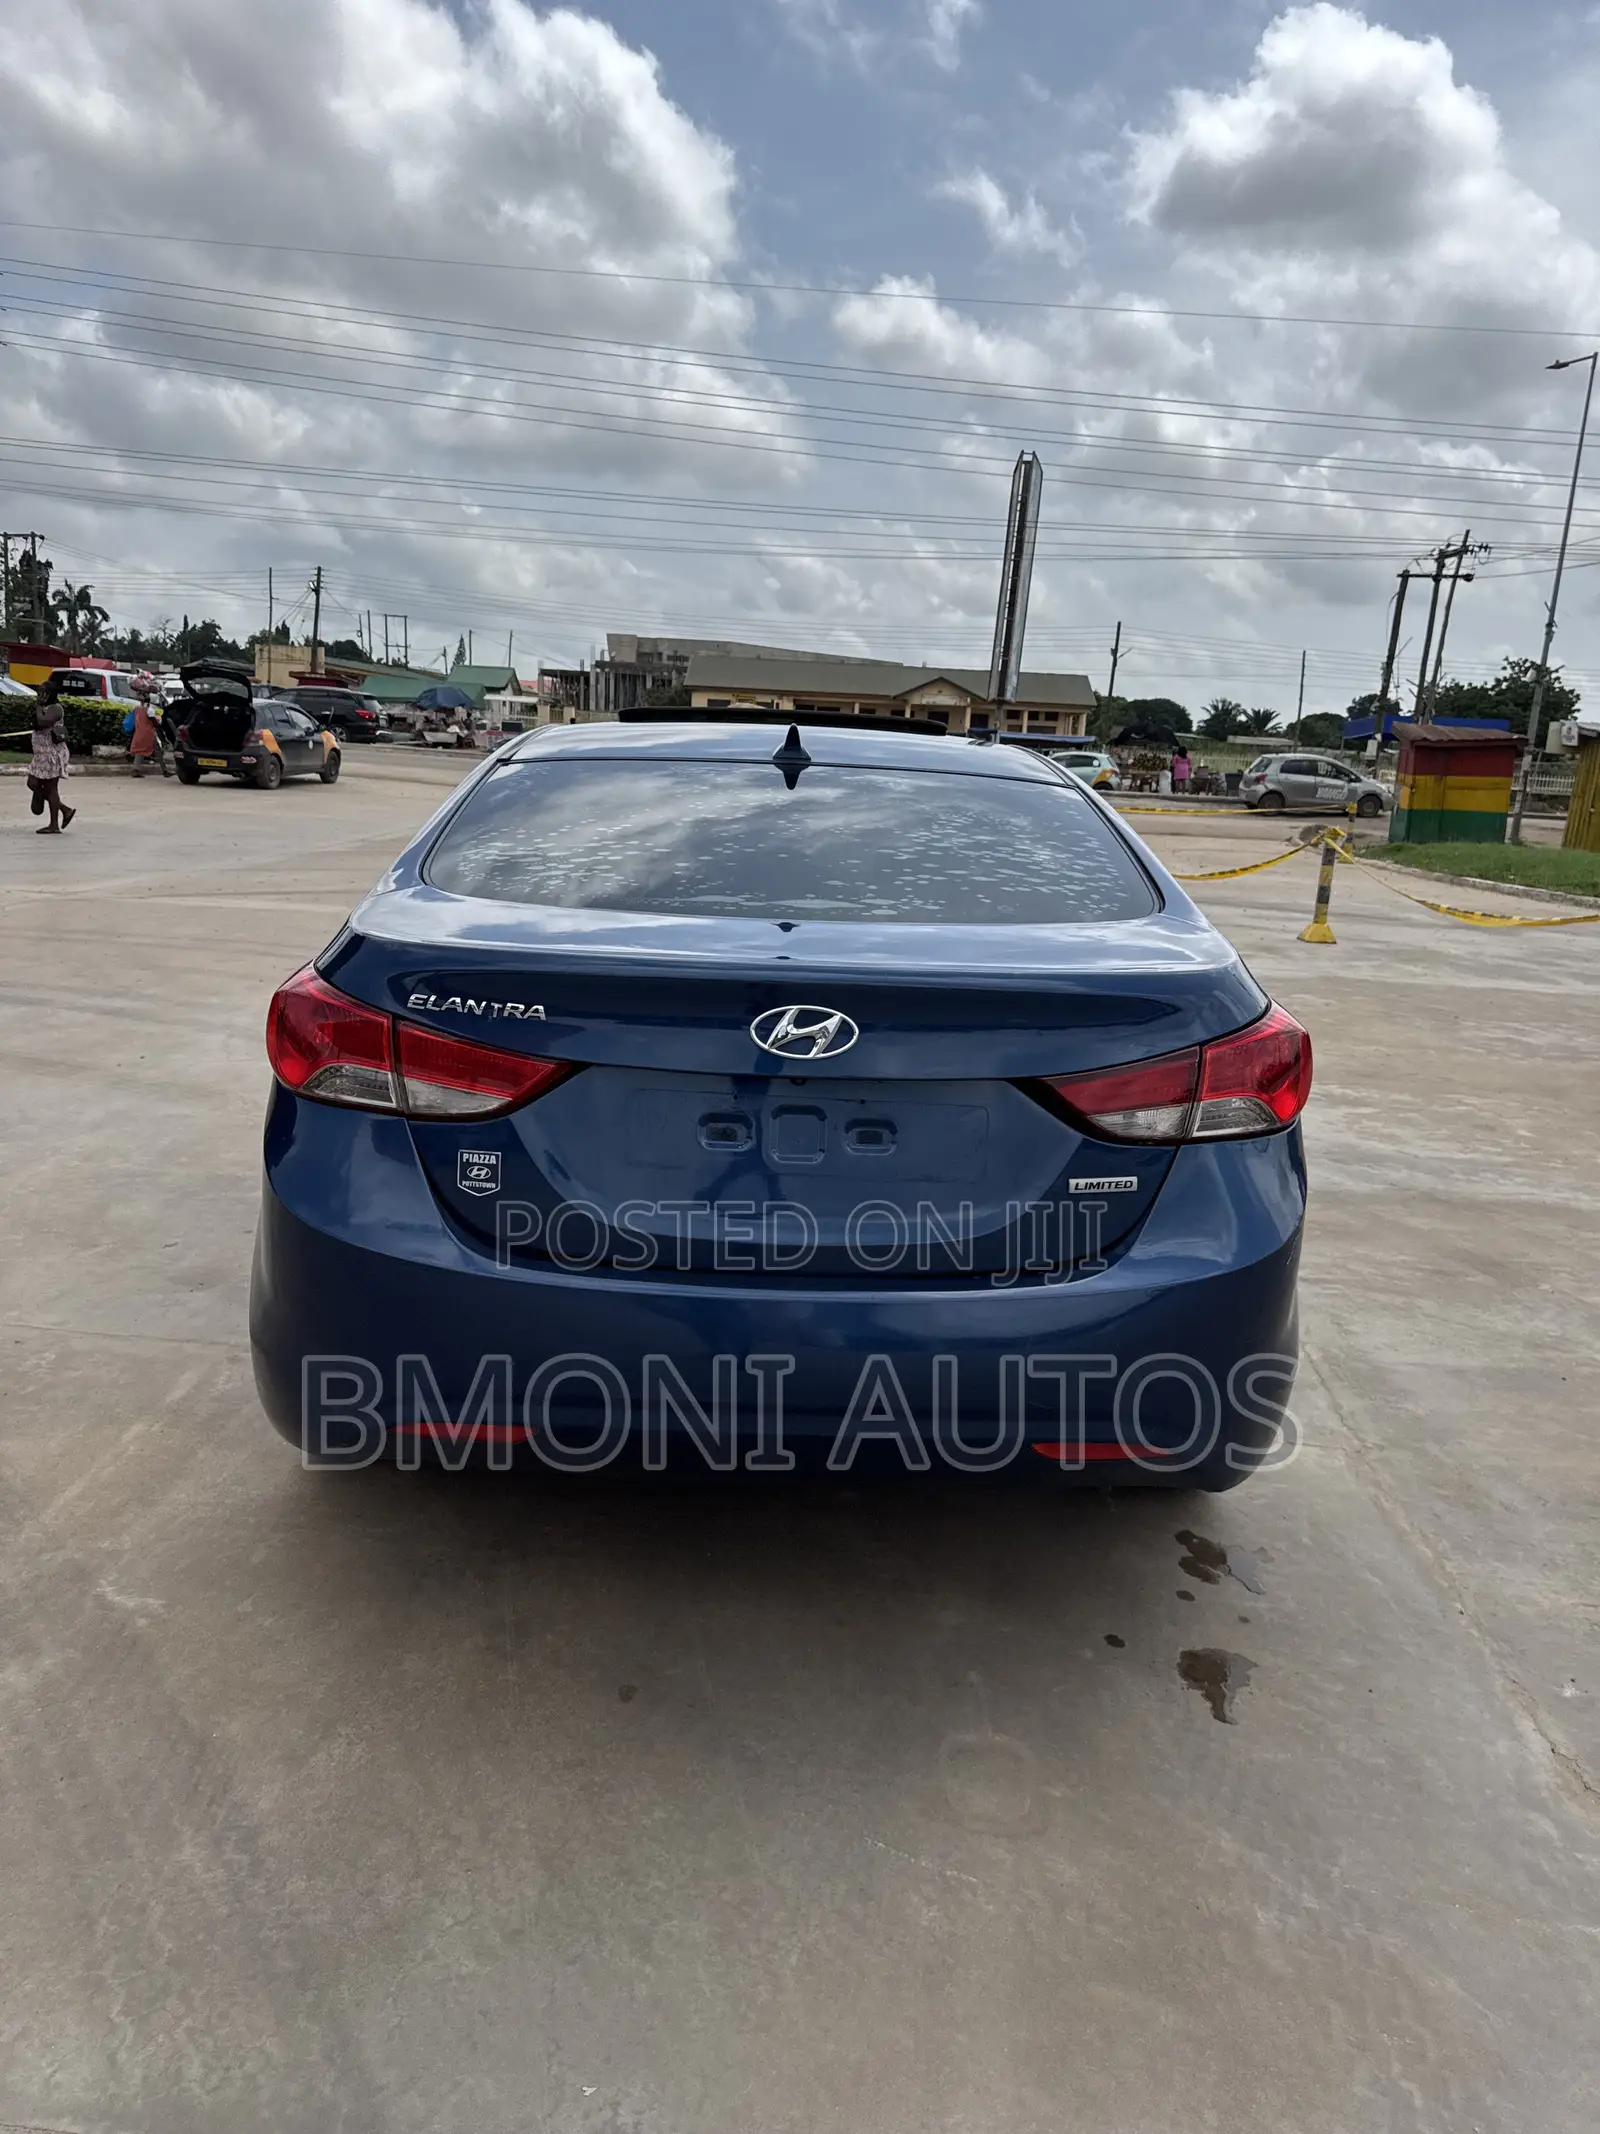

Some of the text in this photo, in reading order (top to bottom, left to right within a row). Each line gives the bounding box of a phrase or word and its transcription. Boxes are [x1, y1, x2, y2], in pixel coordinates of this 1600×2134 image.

[407, 993, 547, 1021] ELANTRA
[462, 1153, 497, 1165] PIAZZA
[461, 1180, 496, 1189] POTTSTOWN
[1074, 1180, 1134, 1191] LIMITED
